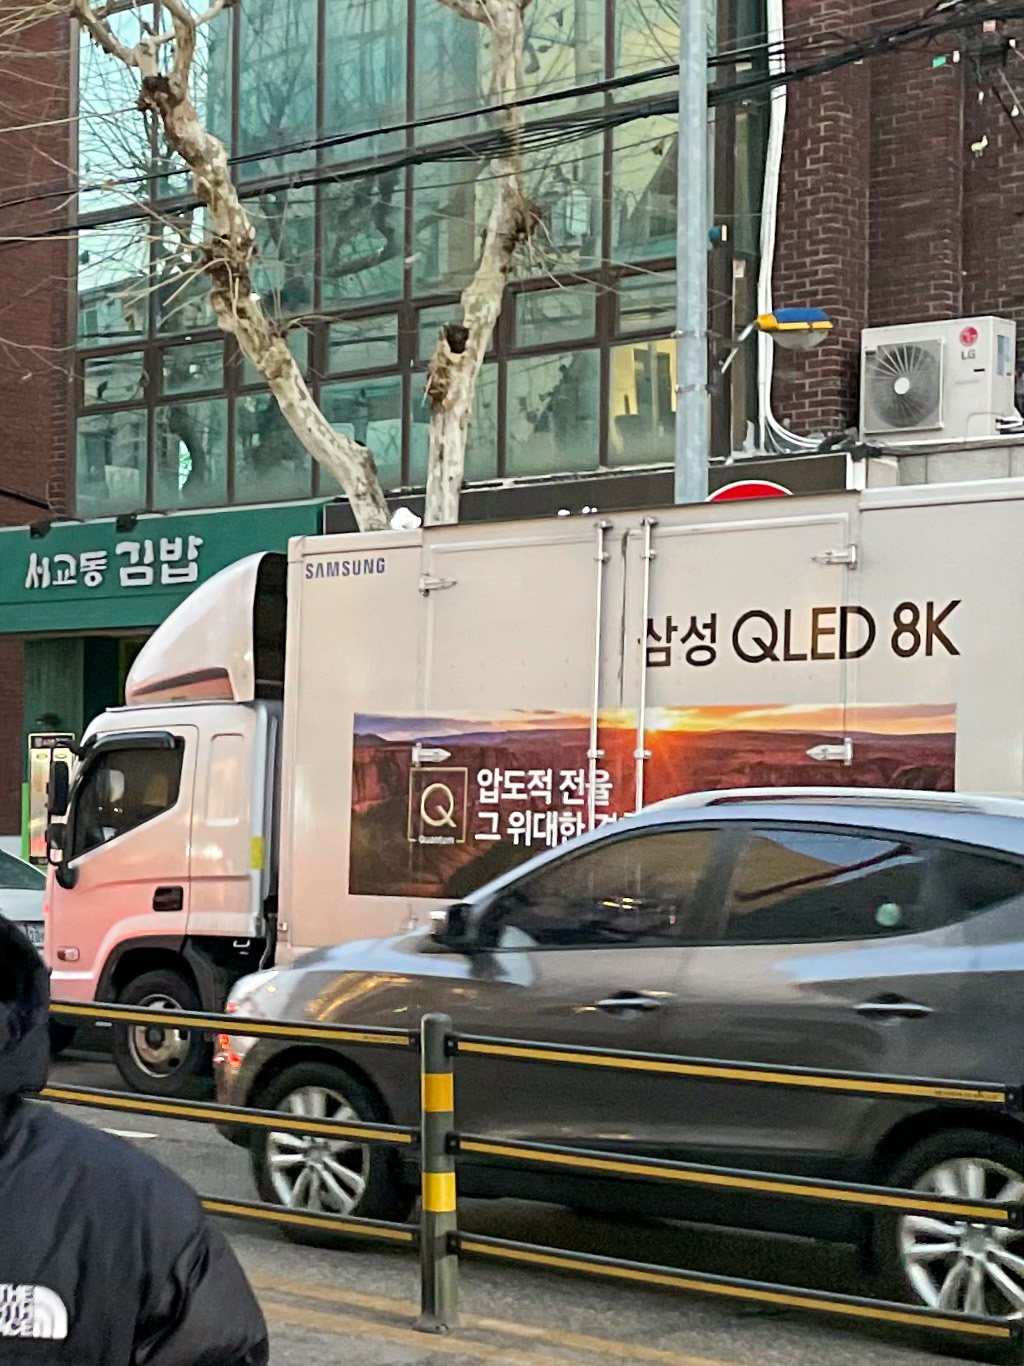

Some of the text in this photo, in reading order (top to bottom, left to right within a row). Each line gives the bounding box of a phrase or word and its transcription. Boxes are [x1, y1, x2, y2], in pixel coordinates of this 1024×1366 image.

[961, 350, 976, 361] LG
[24, 535, 204, 589] 서교동 김밥
[305, 557, 385, 580] SAMSUNG
[640, 599, 962, 668] 삼성 QLED 8K
[420, 782, 457, 828] Q
[476, 767, 614, 807] 압도적 전율
[474, 811, 502, 841] 그
[507, 809, 585, 848] 위대한
